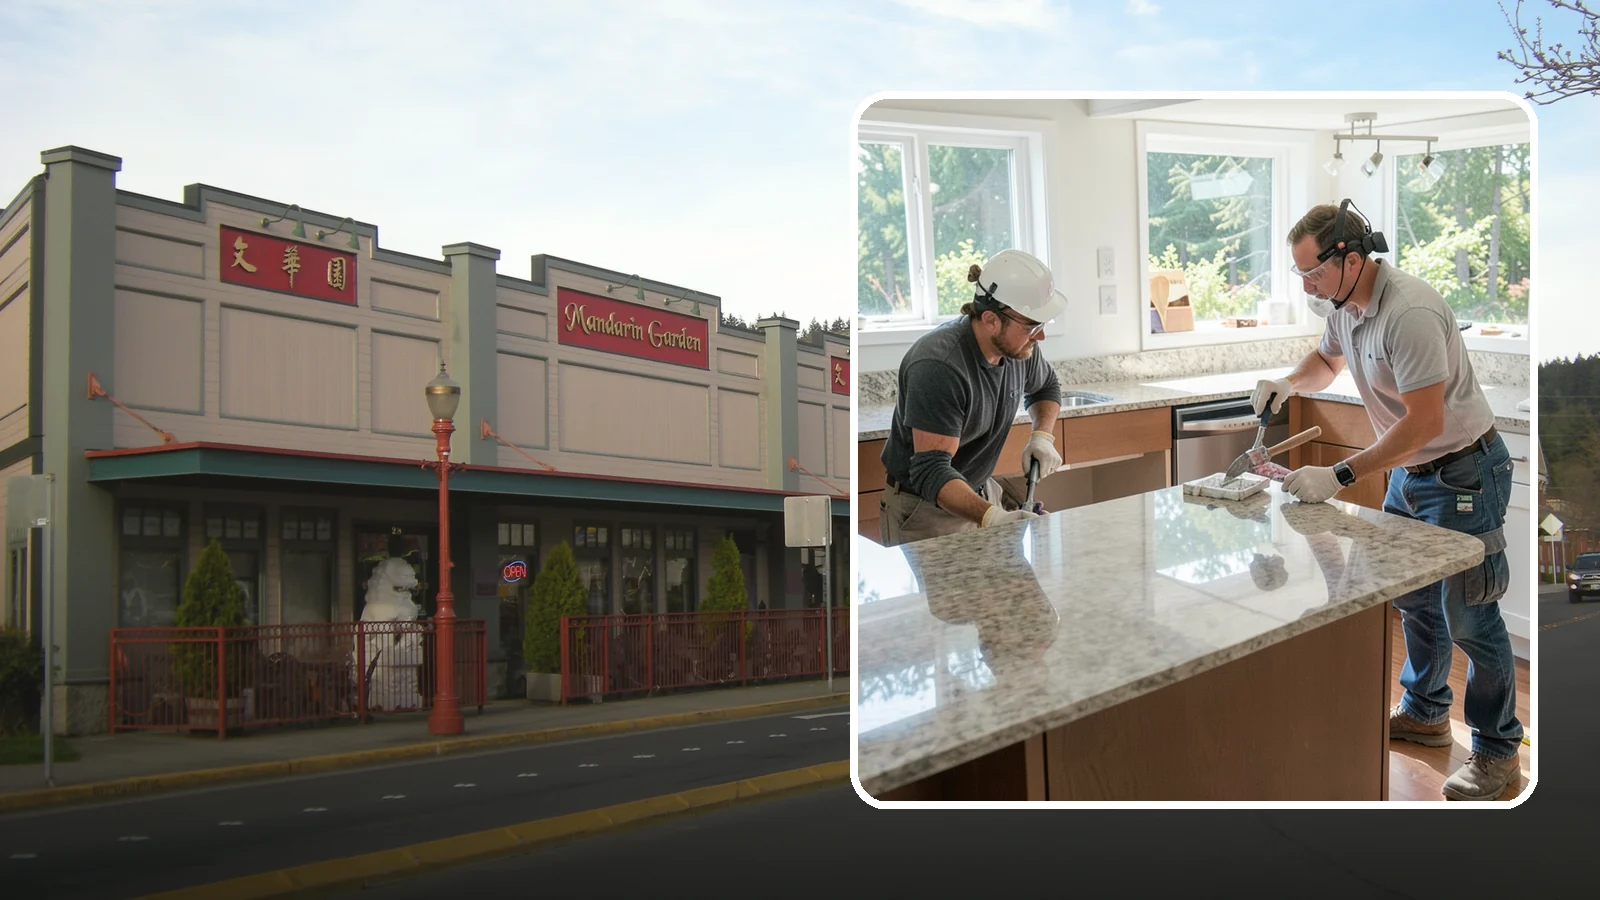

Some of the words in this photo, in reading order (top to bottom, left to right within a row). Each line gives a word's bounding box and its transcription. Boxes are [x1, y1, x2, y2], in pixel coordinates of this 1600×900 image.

[230, 235, 346, 291] 文華園
[564, 302, 644, 341] Mandarin
[647, 320, 702, 353] Garden
[503, 565, 527, 578] OPEN
